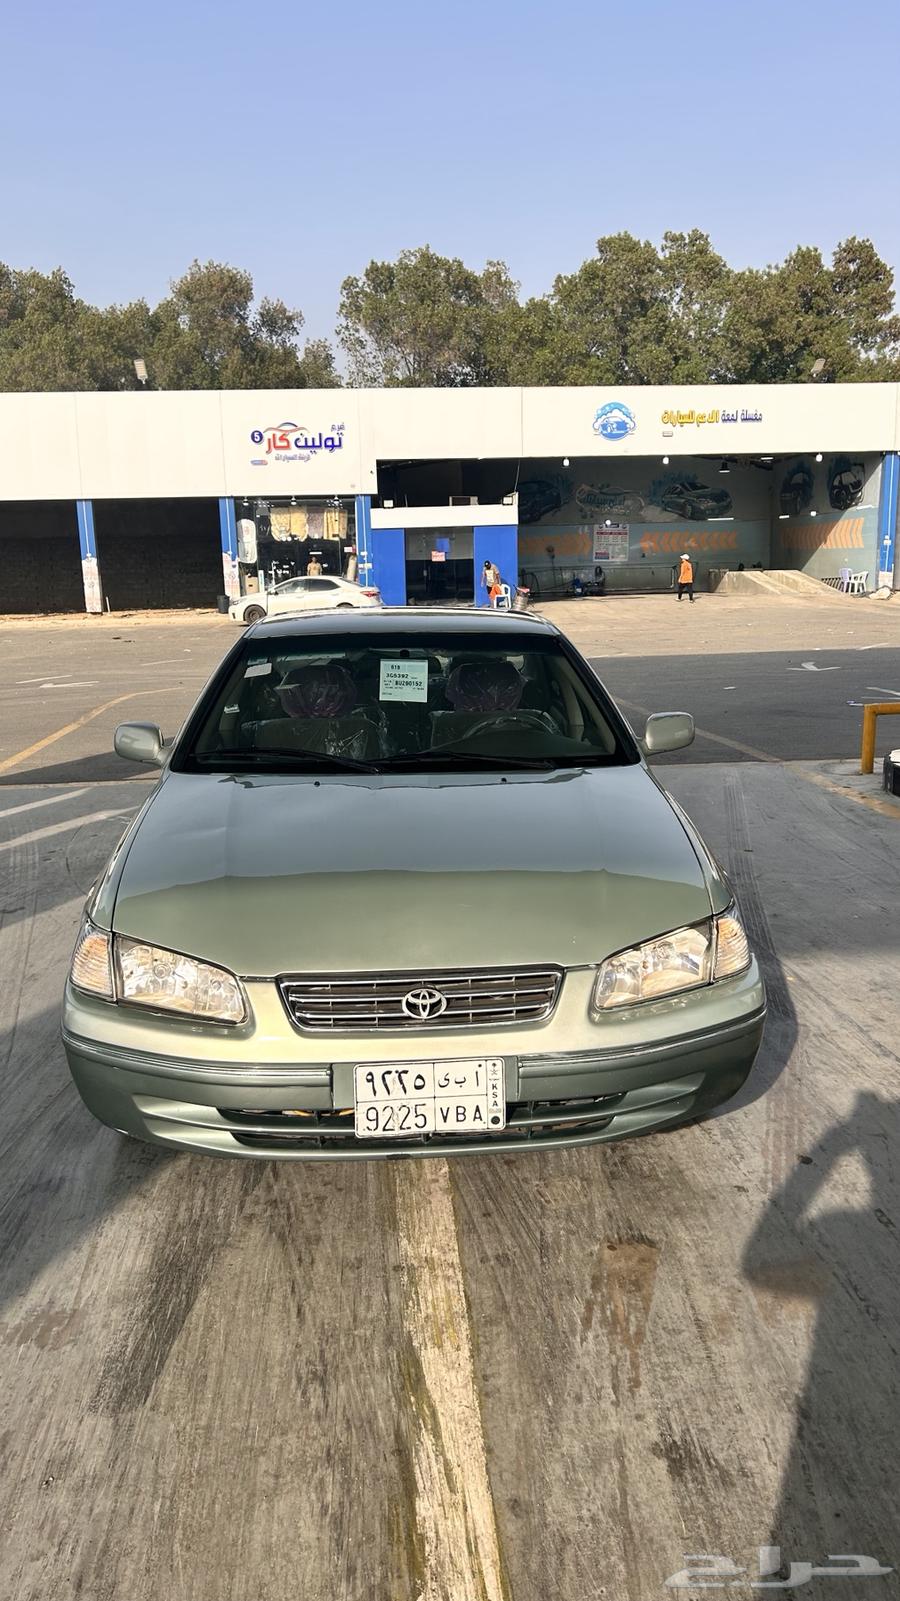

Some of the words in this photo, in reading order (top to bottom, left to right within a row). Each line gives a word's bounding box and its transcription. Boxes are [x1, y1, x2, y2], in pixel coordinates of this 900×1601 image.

[721, 410, 738, 423] لمعة
[740, 409, 763, 423] مغسلة
[265, 431, 291, 454] كار
[294, 432, 344, 455] تولين
[491, 1083, 499, 1107] KSA
[365, 1103, 427, 1132] 9225
